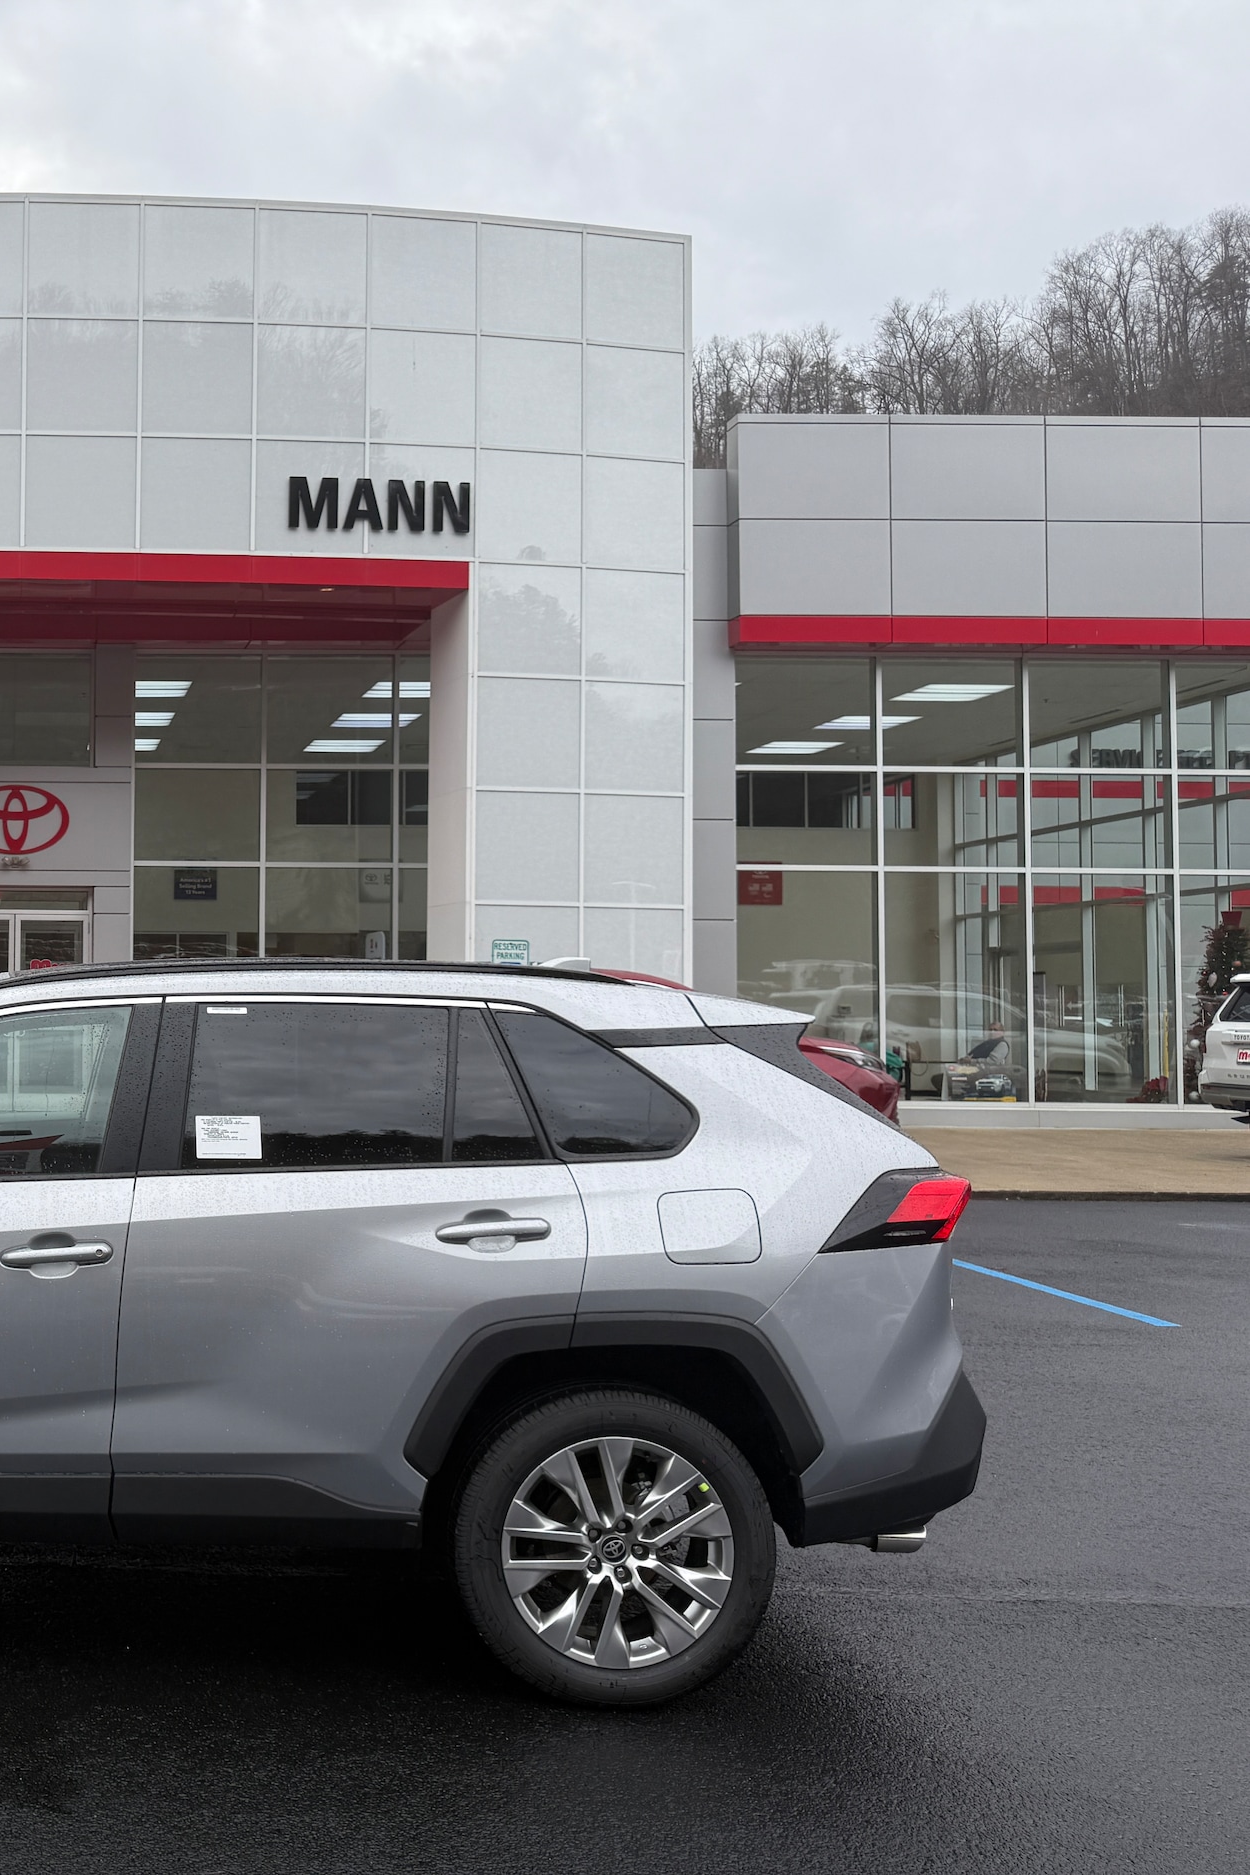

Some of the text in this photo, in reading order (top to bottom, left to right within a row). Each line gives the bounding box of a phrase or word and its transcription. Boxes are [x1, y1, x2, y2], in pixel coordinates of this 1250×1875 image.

[288, 476, 471, 534] MANN
[493, 942, 527, 951] RESERVED
[496, 951, 525, 960] PARKING
